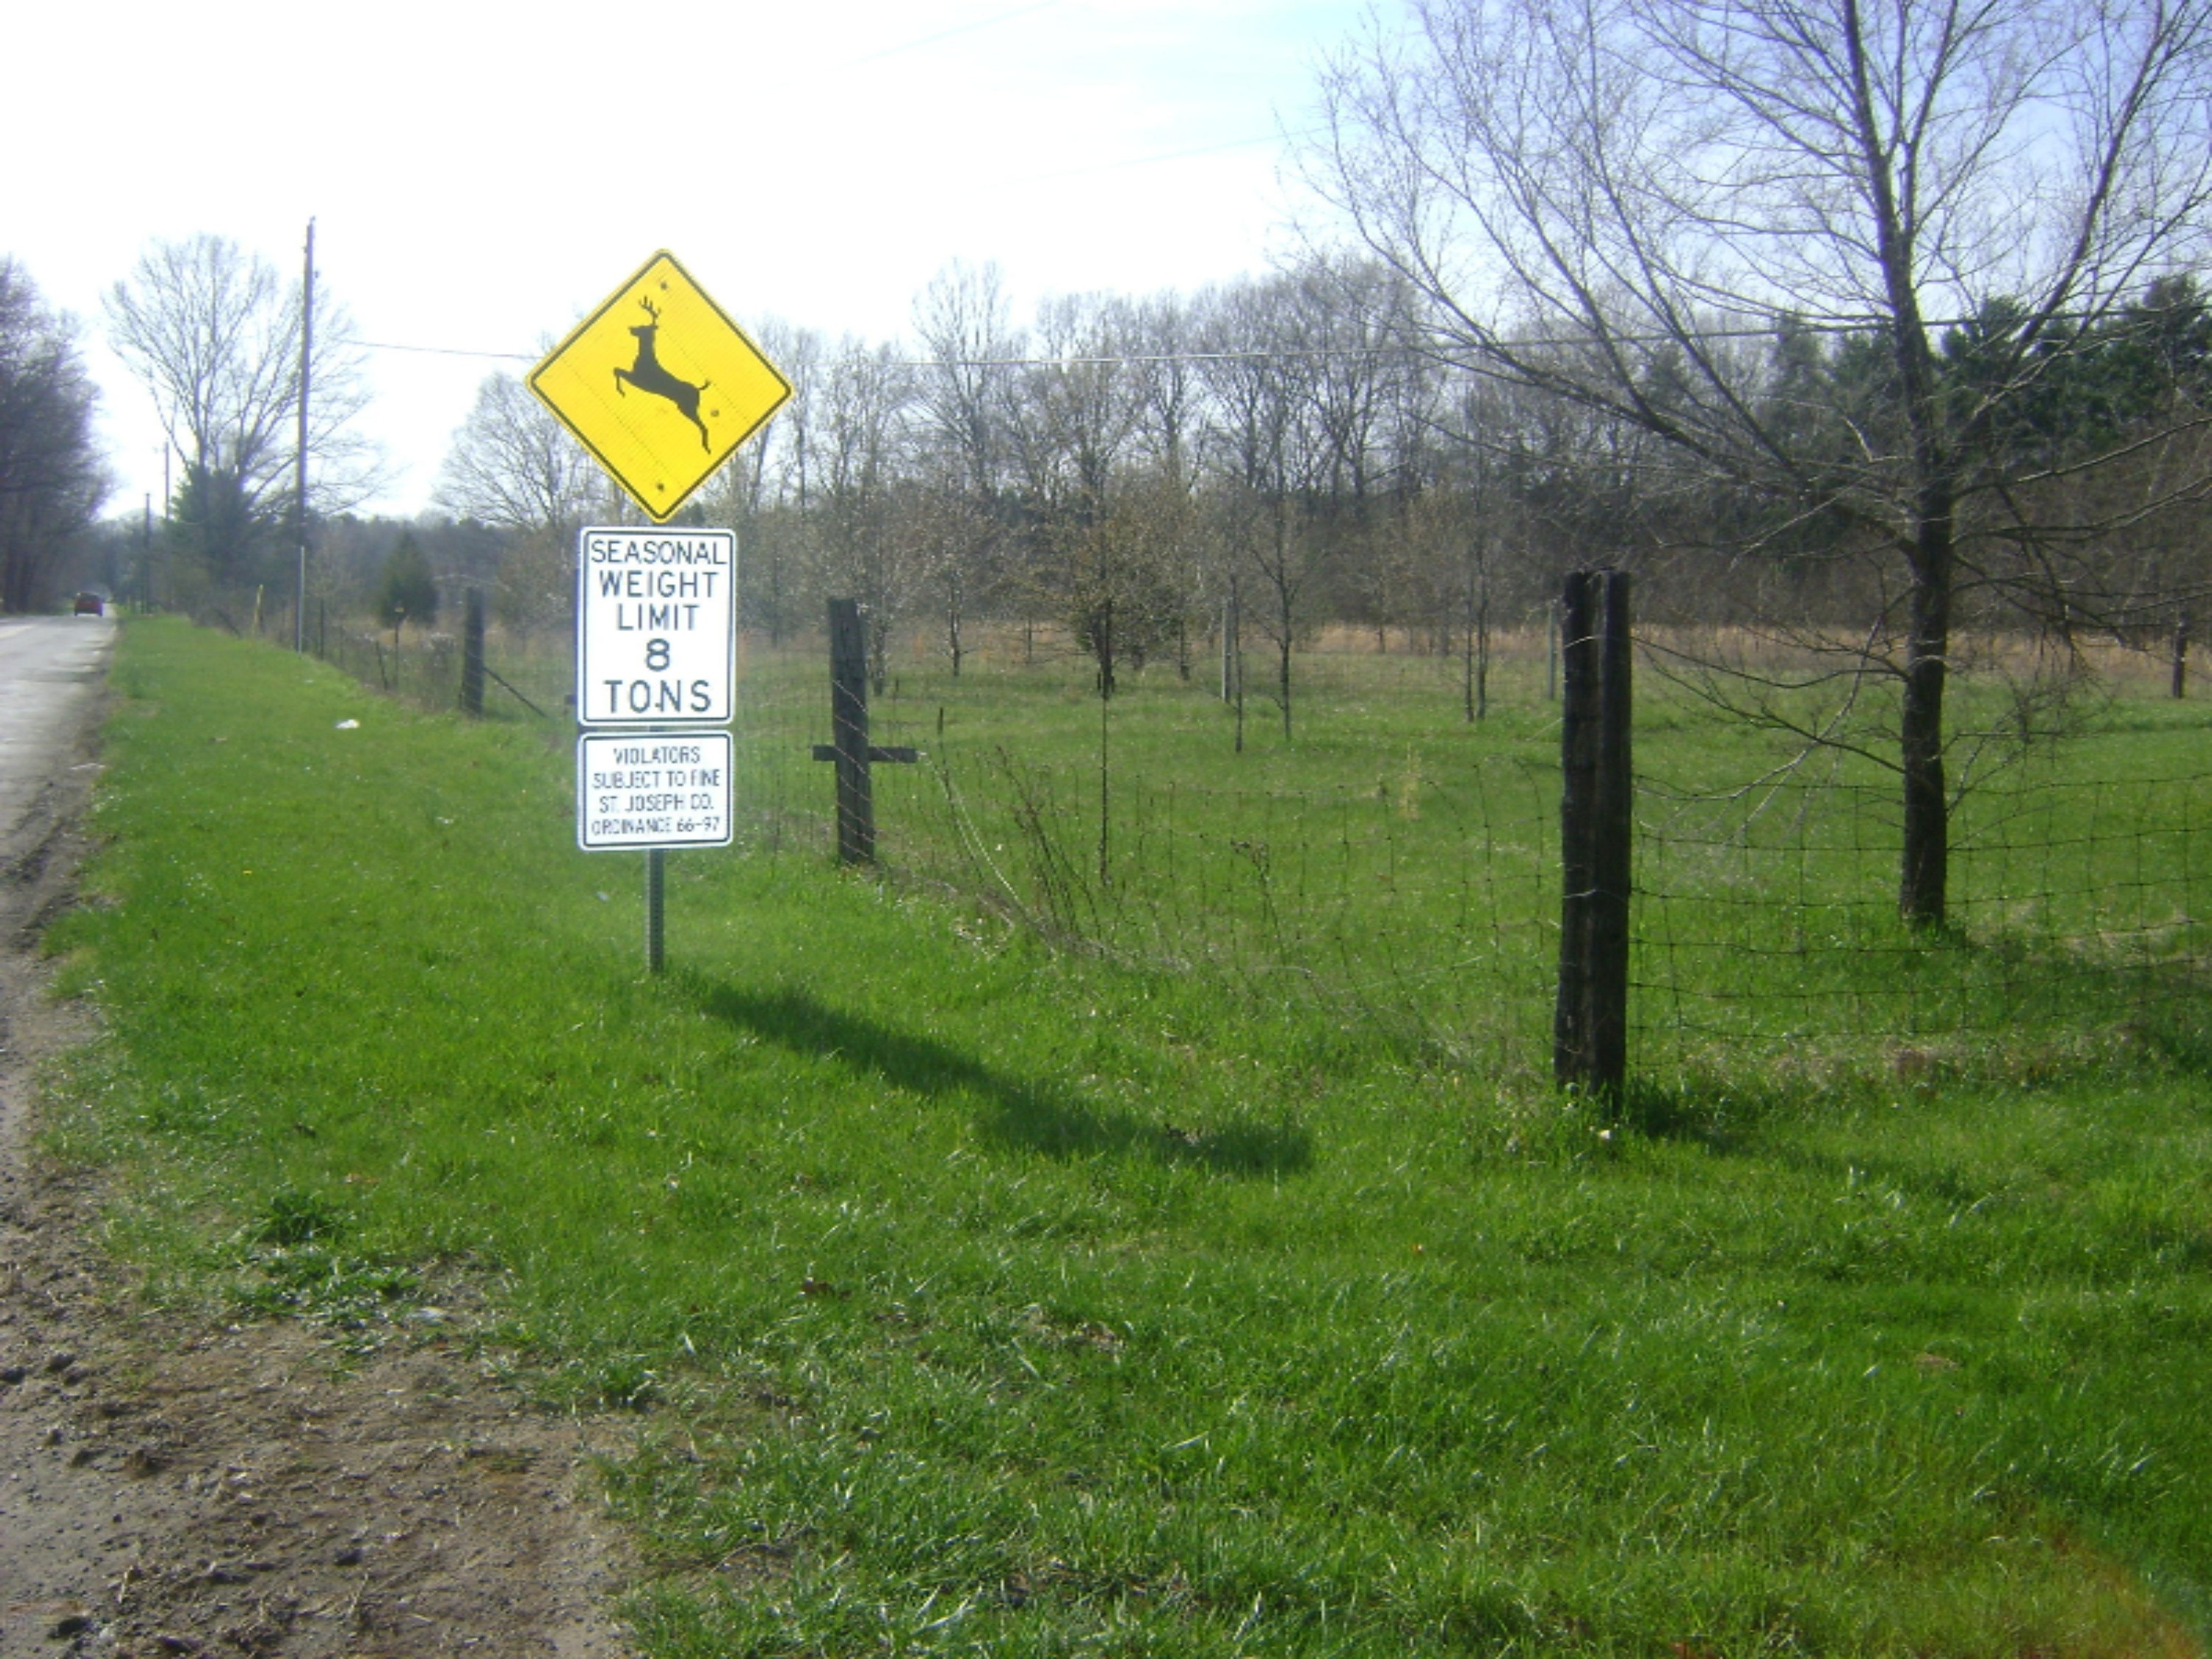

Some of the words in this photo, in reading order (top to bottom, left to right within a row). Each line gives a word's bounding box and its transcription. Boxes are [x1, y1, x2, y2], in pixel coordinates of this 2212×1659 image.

[591, 540, 727, 565] SEASONAL
[599, 570, 719, 597] WEIGHT
[616, 603, 700, 630] LIMIT
[645, 638, 670, 672] 8
[603, 679, 712, 713] TONS
[613, 746, 700, 765] VIOLATORS
[592, 771, 661, 789] SUBJECT
[667, 771, 686, 787] TO
[691, 769, 720, 787] FINE
[625, 794, 686, 811] JOSEPH
[691, 793, 714, 810] CO.
[591, 817, 672, 835] ORDINANCE
[677, 816, 720, 832] 66-97
